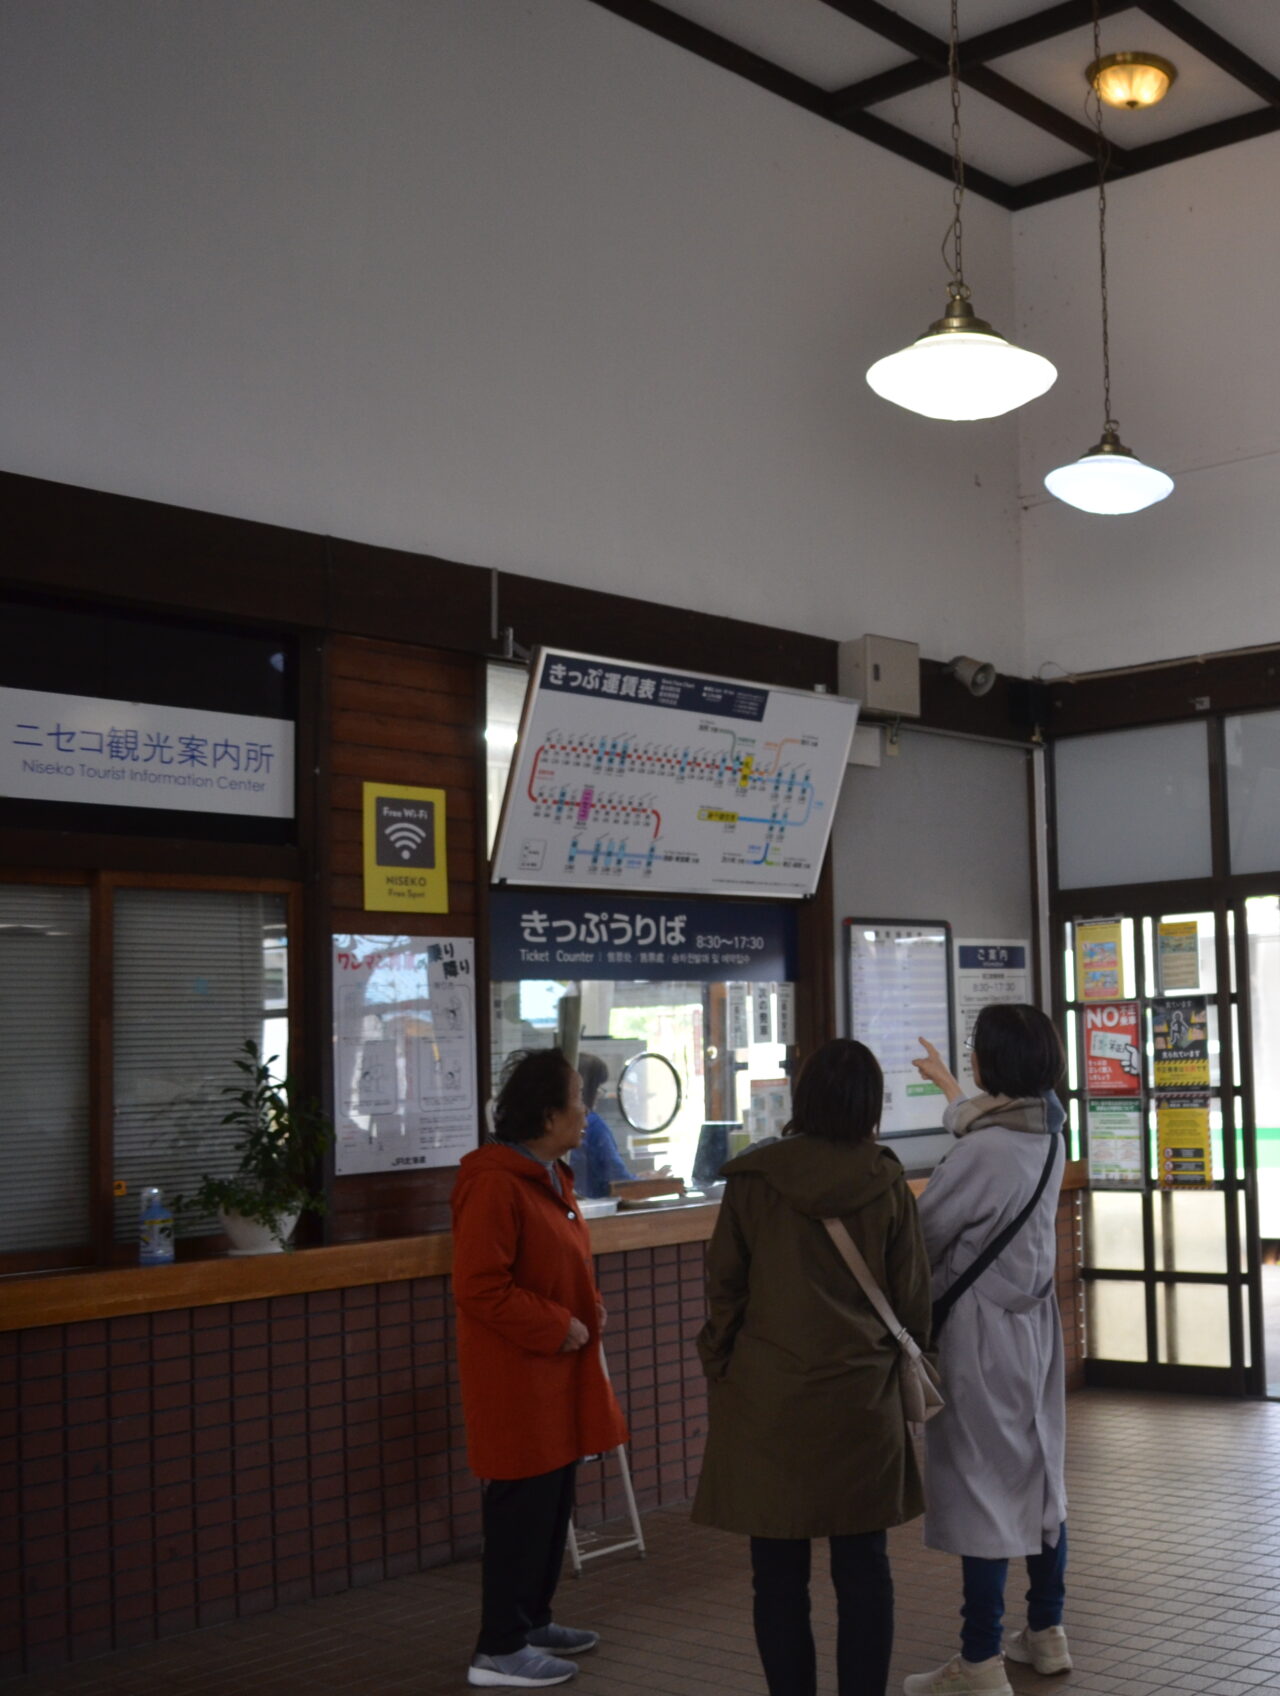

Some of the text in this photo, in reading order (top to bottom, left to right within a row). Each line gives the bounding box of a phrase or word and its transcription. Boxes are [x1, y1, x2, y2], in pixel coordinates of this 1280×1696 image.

[549, 663, 656, 700] きっぷ運賃表
[12, 722, 275, 774] ニセコ観光案内所
[22, 759, 266, 793] Niseko Tourist Information Center
[382, 806, 428, 820] Free Wi-Fi
[386, 875, 427, 887] NISEKO
[520, 910, 687, 946] きっぷうりば
[520, 949, 550, 962] Ticket
[556, 950, 594, 963] Counter
[977, 948, 1009, 963] ご案内
[1087, 1006, 1120, 1029] NO
